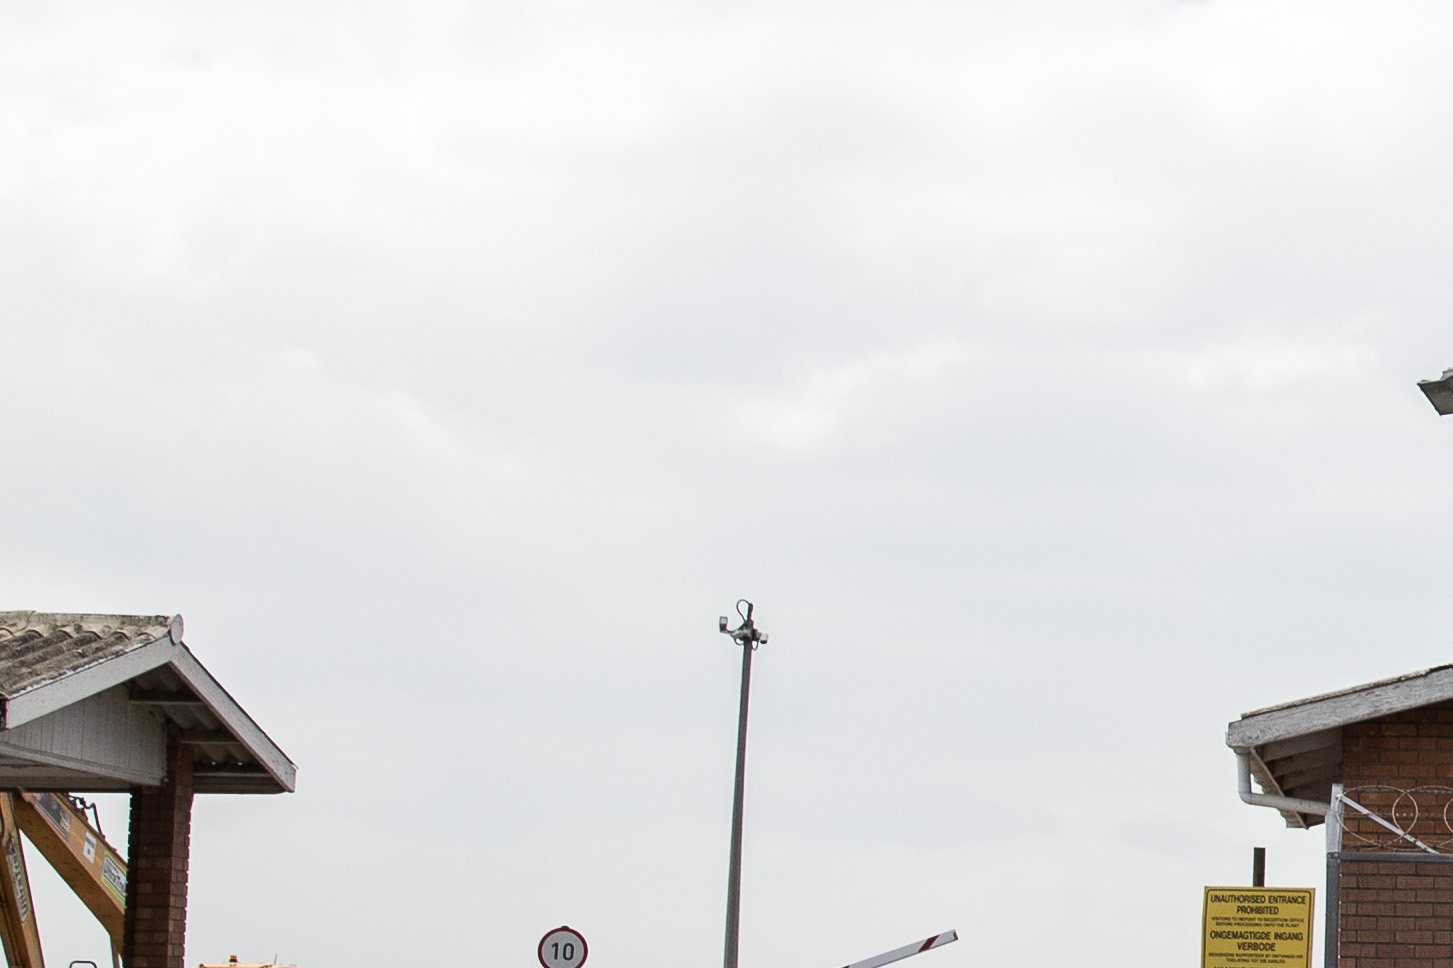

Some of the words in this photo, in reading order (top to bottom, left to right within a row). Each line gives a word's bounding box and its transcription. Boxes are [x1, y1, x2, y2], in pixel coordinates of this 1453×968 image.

[1211, 894, 1266, 904] UNAUTHORISED
[1268, 895, 1306, 905] ENTRANCE
[1236, 905, 1279, 915] PROHIBITED
[1274, 931, 1303, 941] INGANG
[551, 942, 574, 961] 10
[1237, 942, 1276, 951] VERBODE
